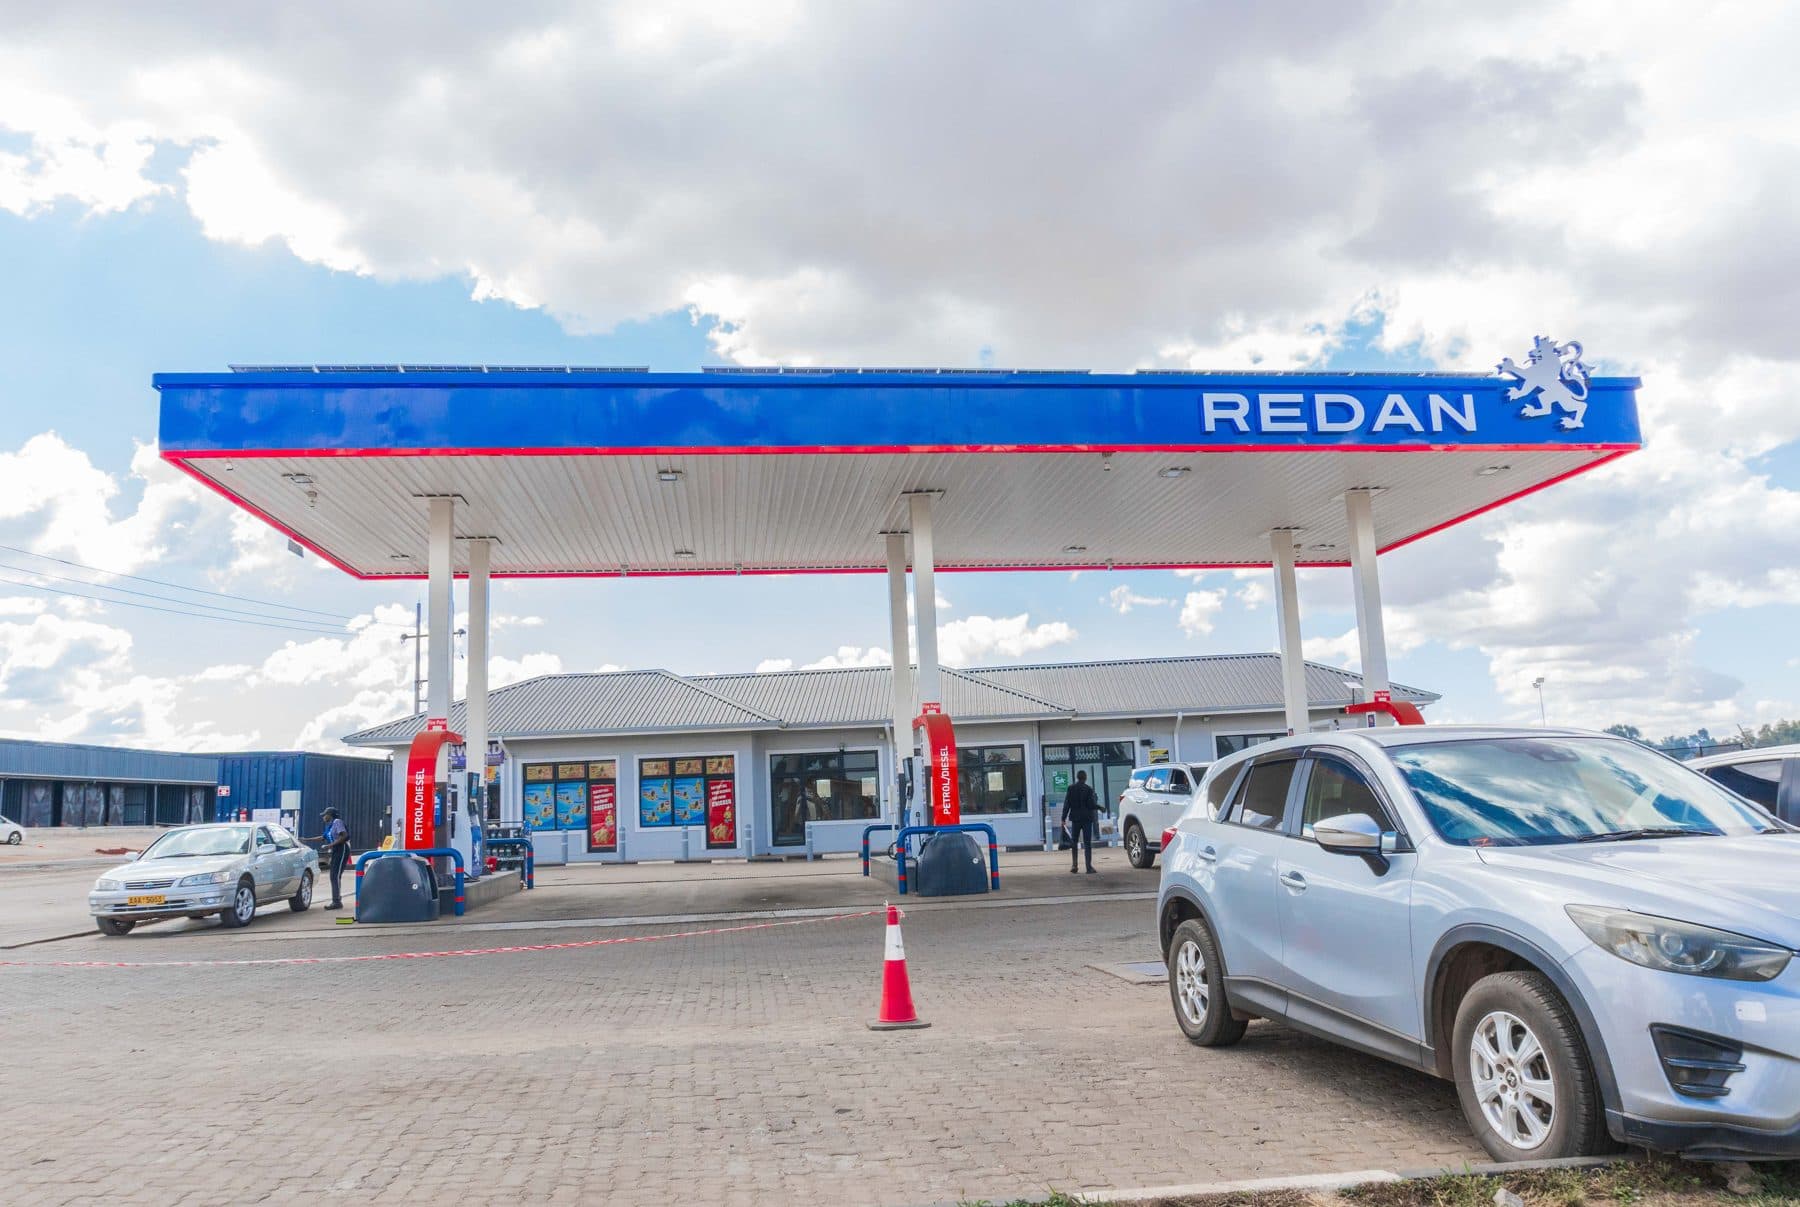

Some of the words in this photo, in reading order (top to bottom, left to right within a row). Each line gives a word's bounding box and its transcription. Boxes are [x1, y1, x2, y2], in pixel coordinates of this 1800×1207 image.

[1202, 393, 1477, 434] REDAN
[414, 768, 425, 841] PETROL/DIESEL
[940, 745, 951, 815] PETROL/DIESEL
